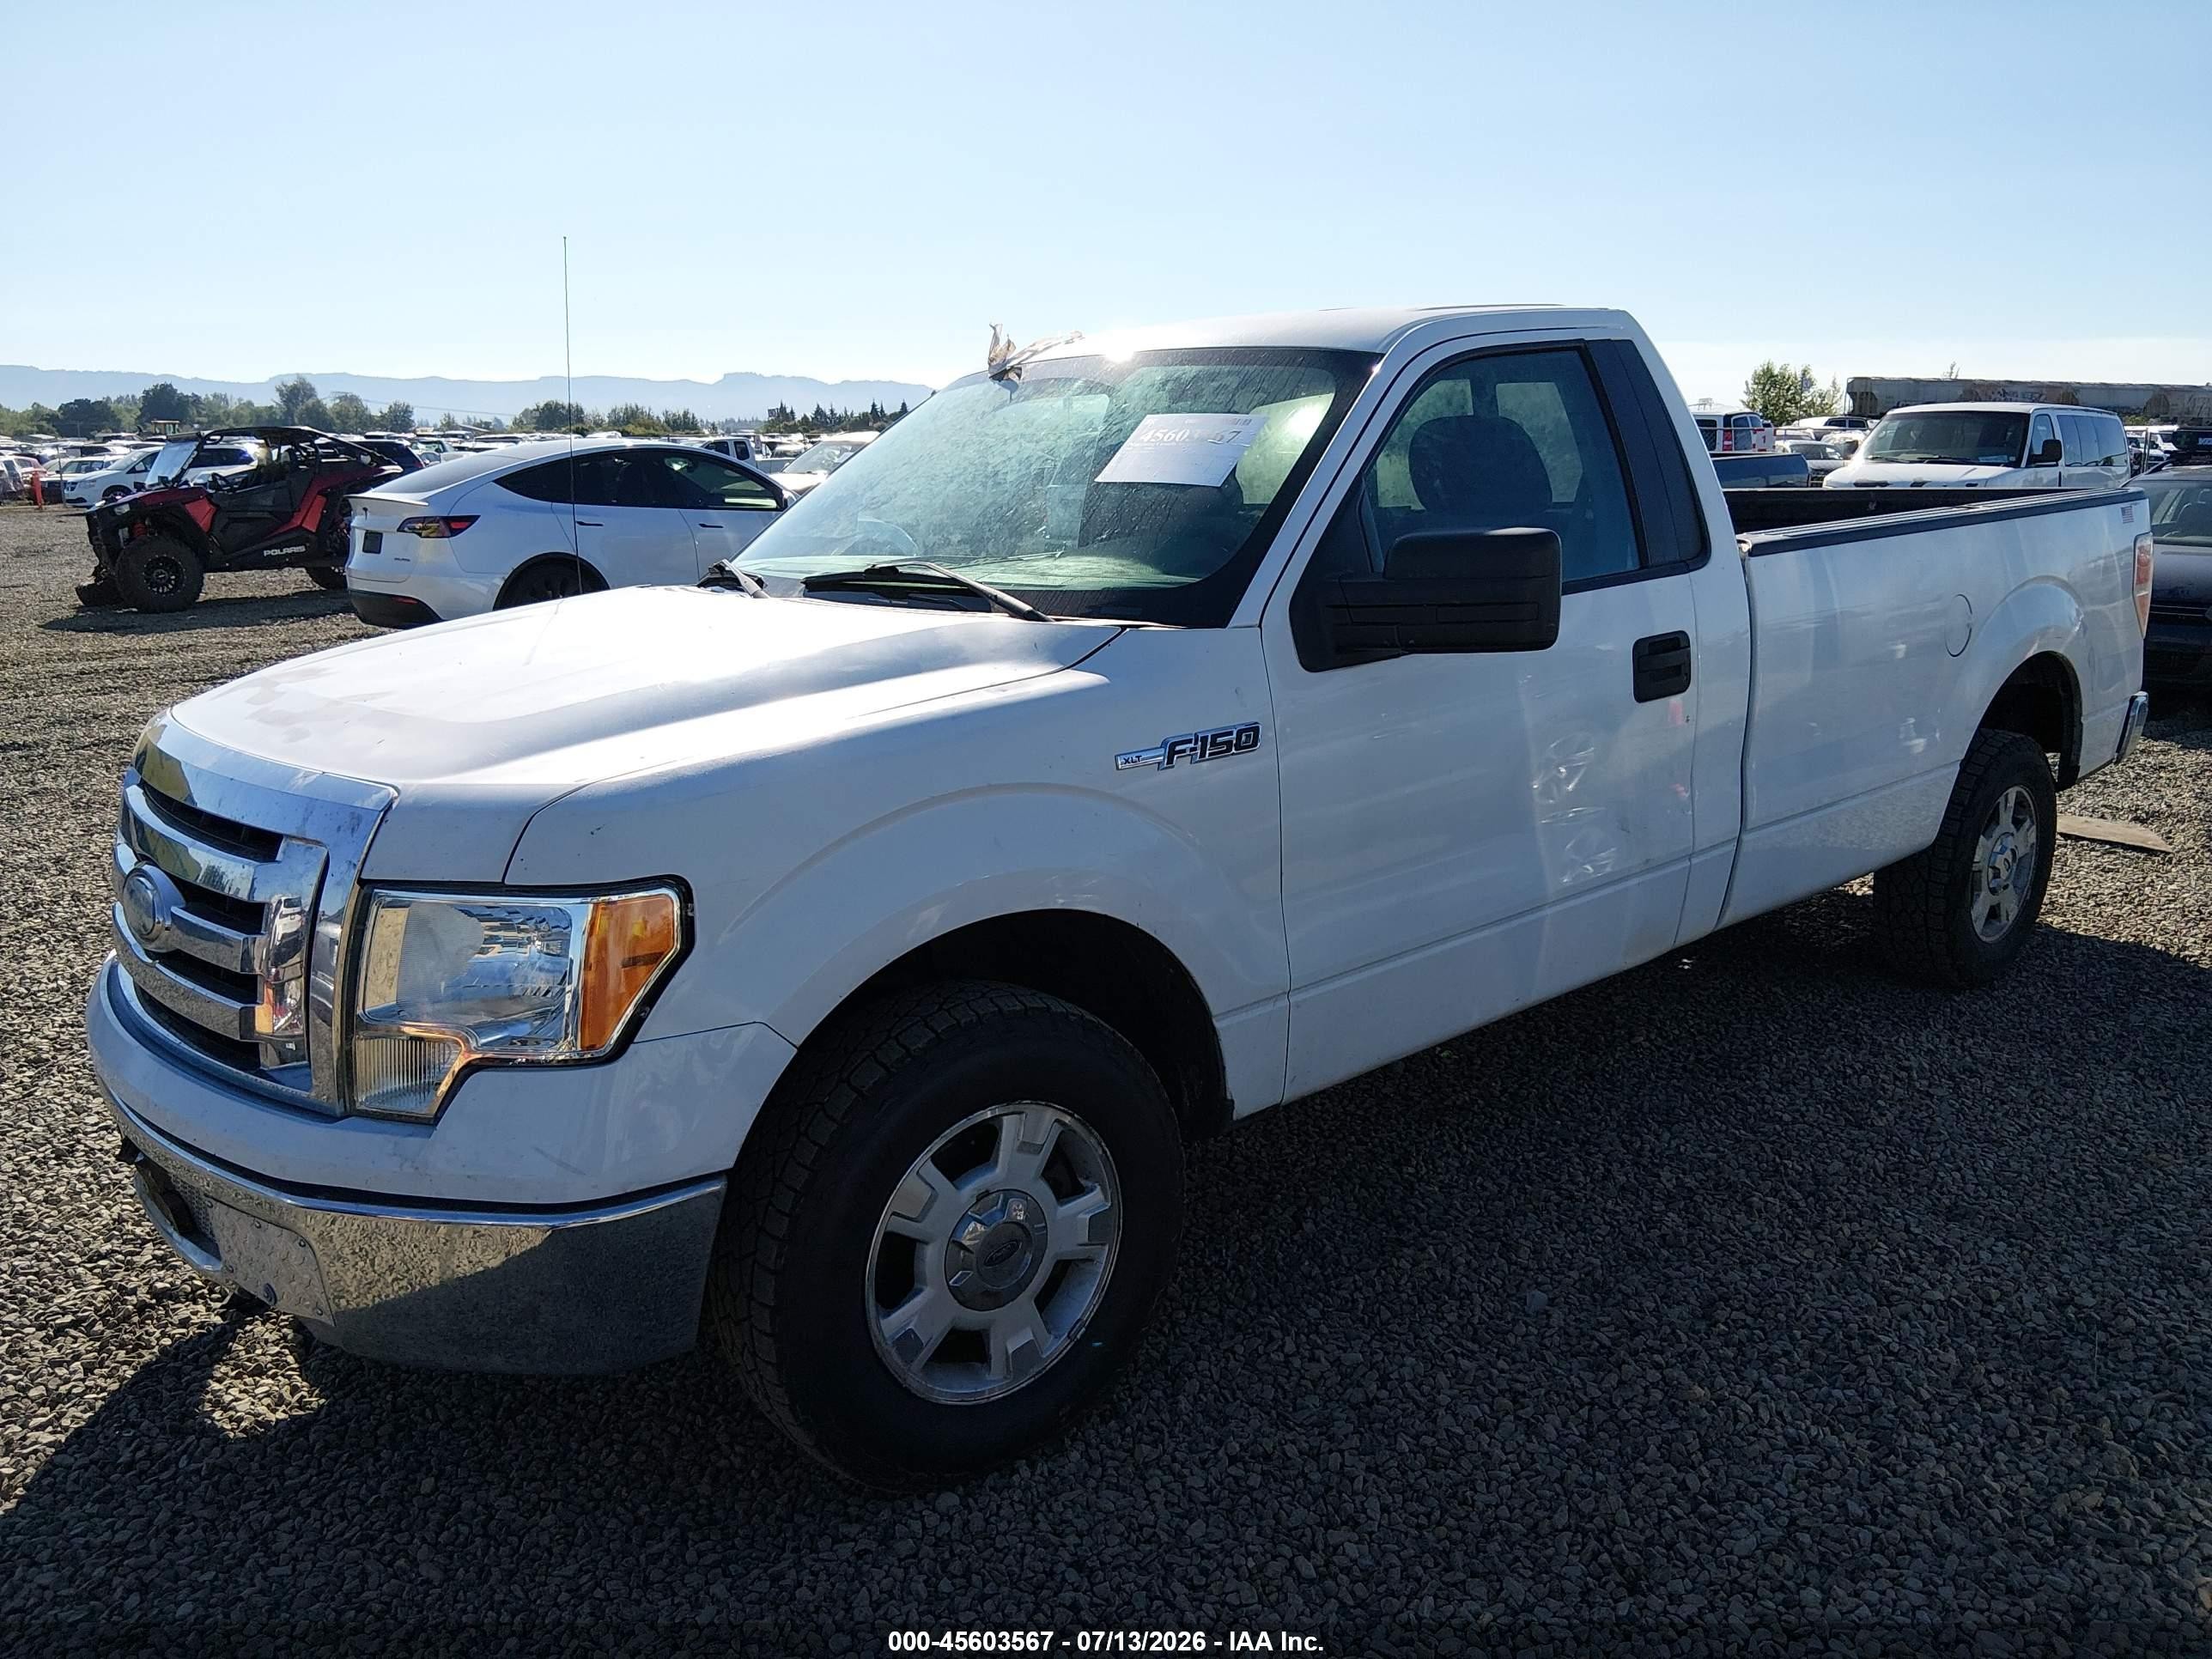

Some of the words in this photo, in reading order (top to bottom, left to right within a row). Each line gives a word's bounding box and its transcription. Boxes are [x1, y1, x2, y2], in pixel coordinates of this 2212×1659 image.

[1139, 428, 1243, 444] 456067
[263, 545, 307, 556] POLARIS
[1121, 754, 1143, 766] XLT
[1164, 723, 1262, 767] F-150
